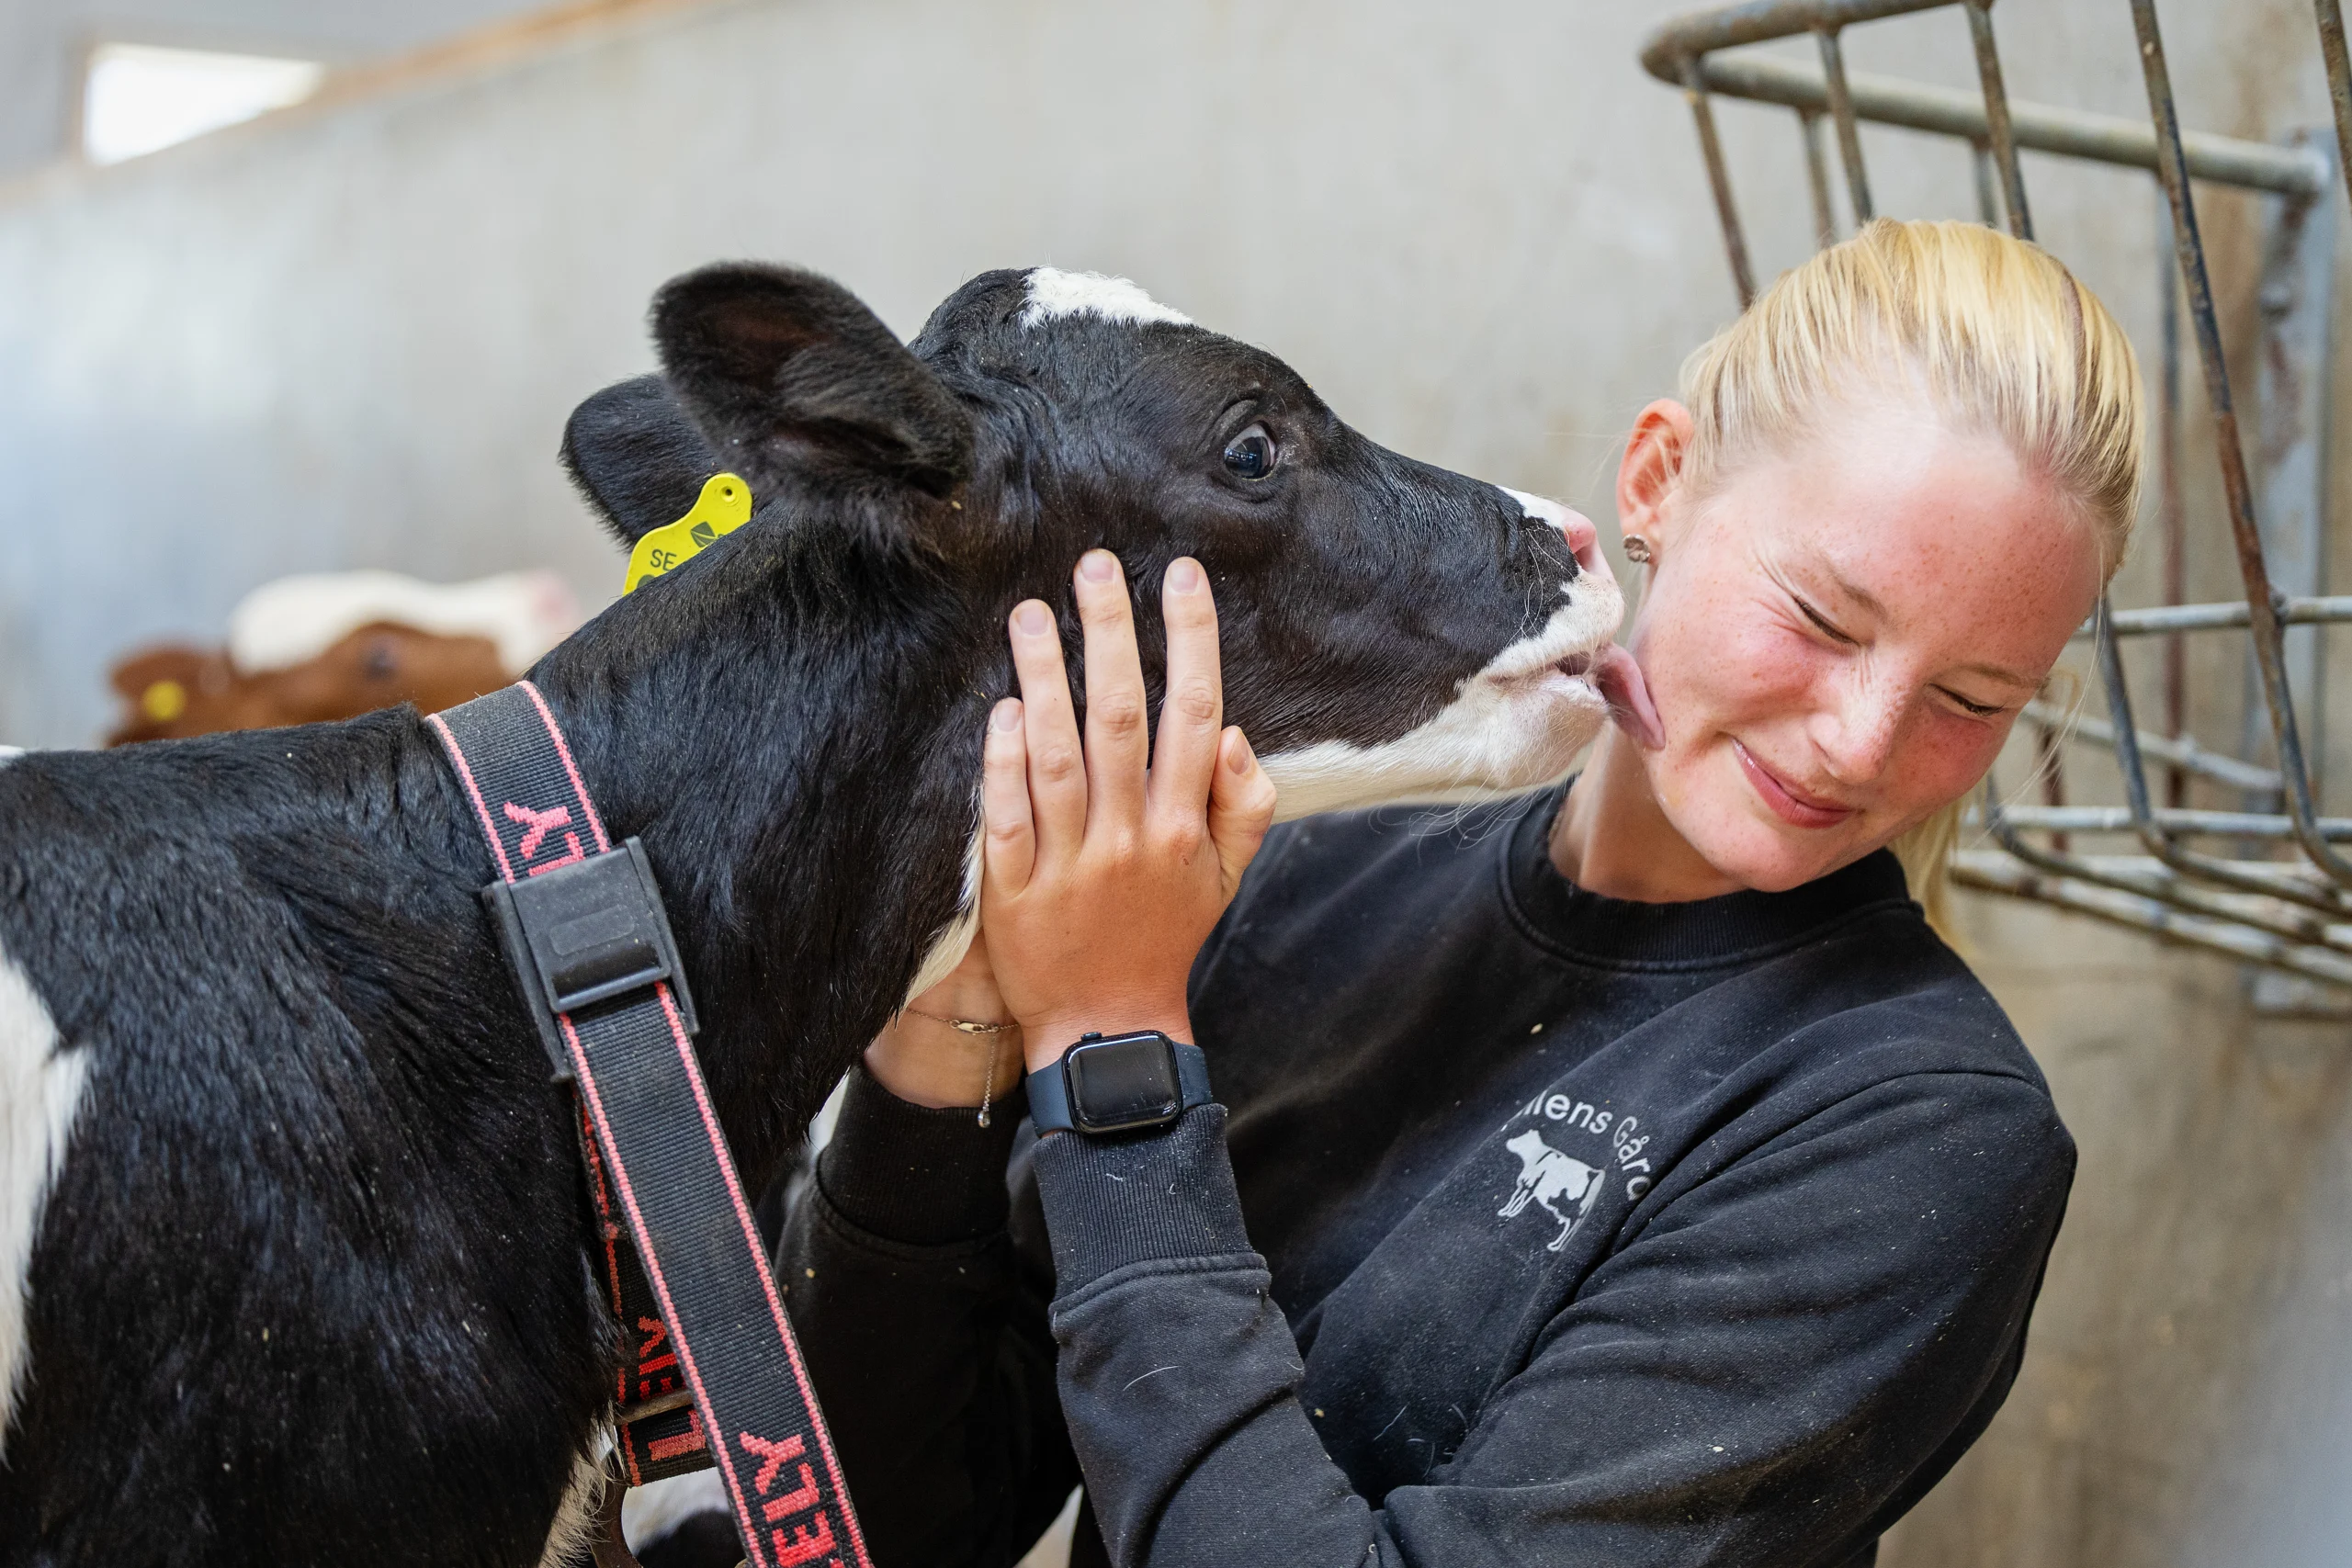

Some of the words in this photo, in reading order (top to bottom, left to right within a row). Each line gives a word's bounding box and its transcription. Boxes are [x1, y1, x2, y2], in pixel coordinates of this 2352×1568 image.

[650, 548, 677, 571] SE
[503, 801, 587, 877] LY
[739, 1430, 845, 1568] ELY
